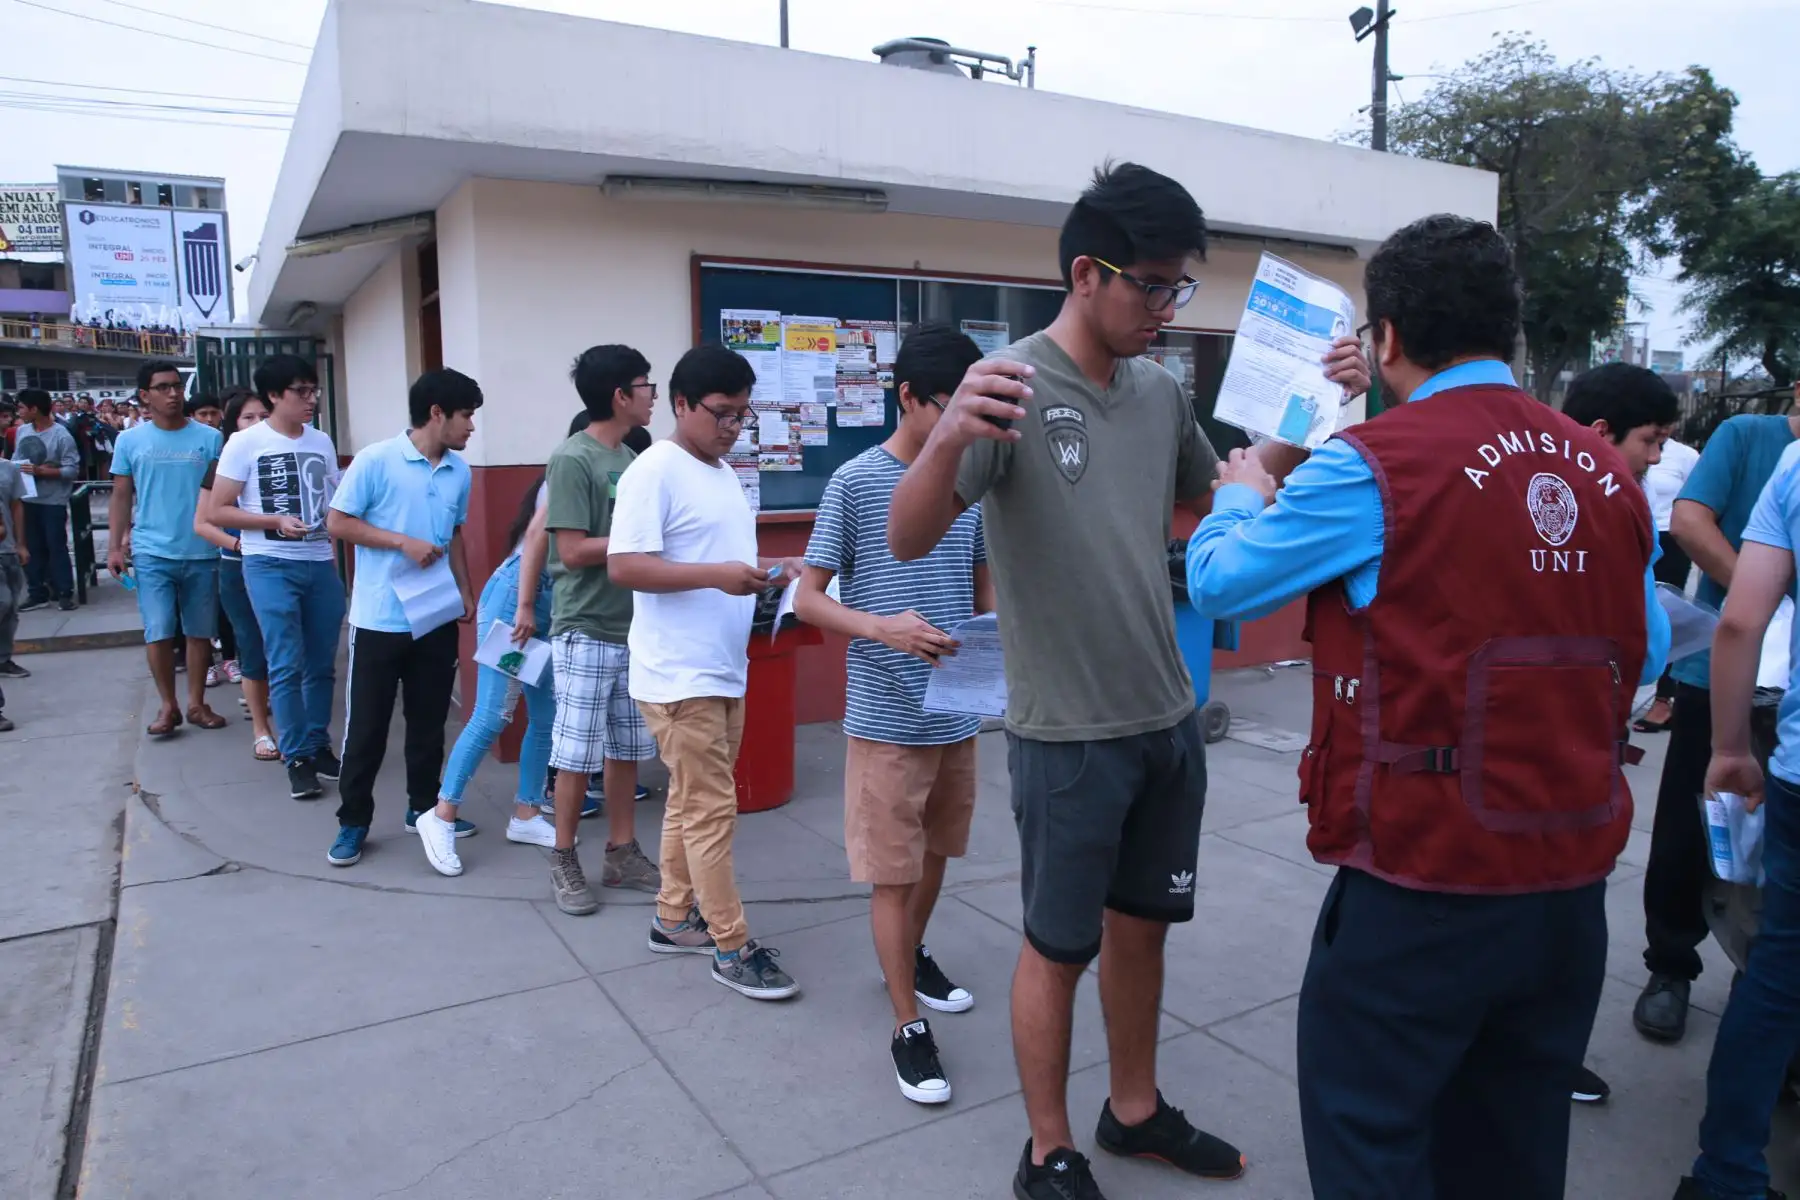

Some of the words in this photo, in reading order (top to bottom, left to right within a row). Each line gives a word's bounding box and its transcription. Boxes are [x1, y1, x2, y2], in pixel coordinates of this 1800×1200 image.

[46, 192, 56, 201] Y
[0, 214, 20, 223] SAN
[18, 225, 32, 235] 04
[88, 243, 133, 252] INTEGRAL
[116, 253, 133, 261] UNI
[91, 271, 136, 279] INTEGRAL
[99, 390, 127, 398] DE
[1464, 430, 1621, 498] ADMISION
[270, 456, 288, 490] KLEIN
[1529, 549, 1588, 573] UNI
